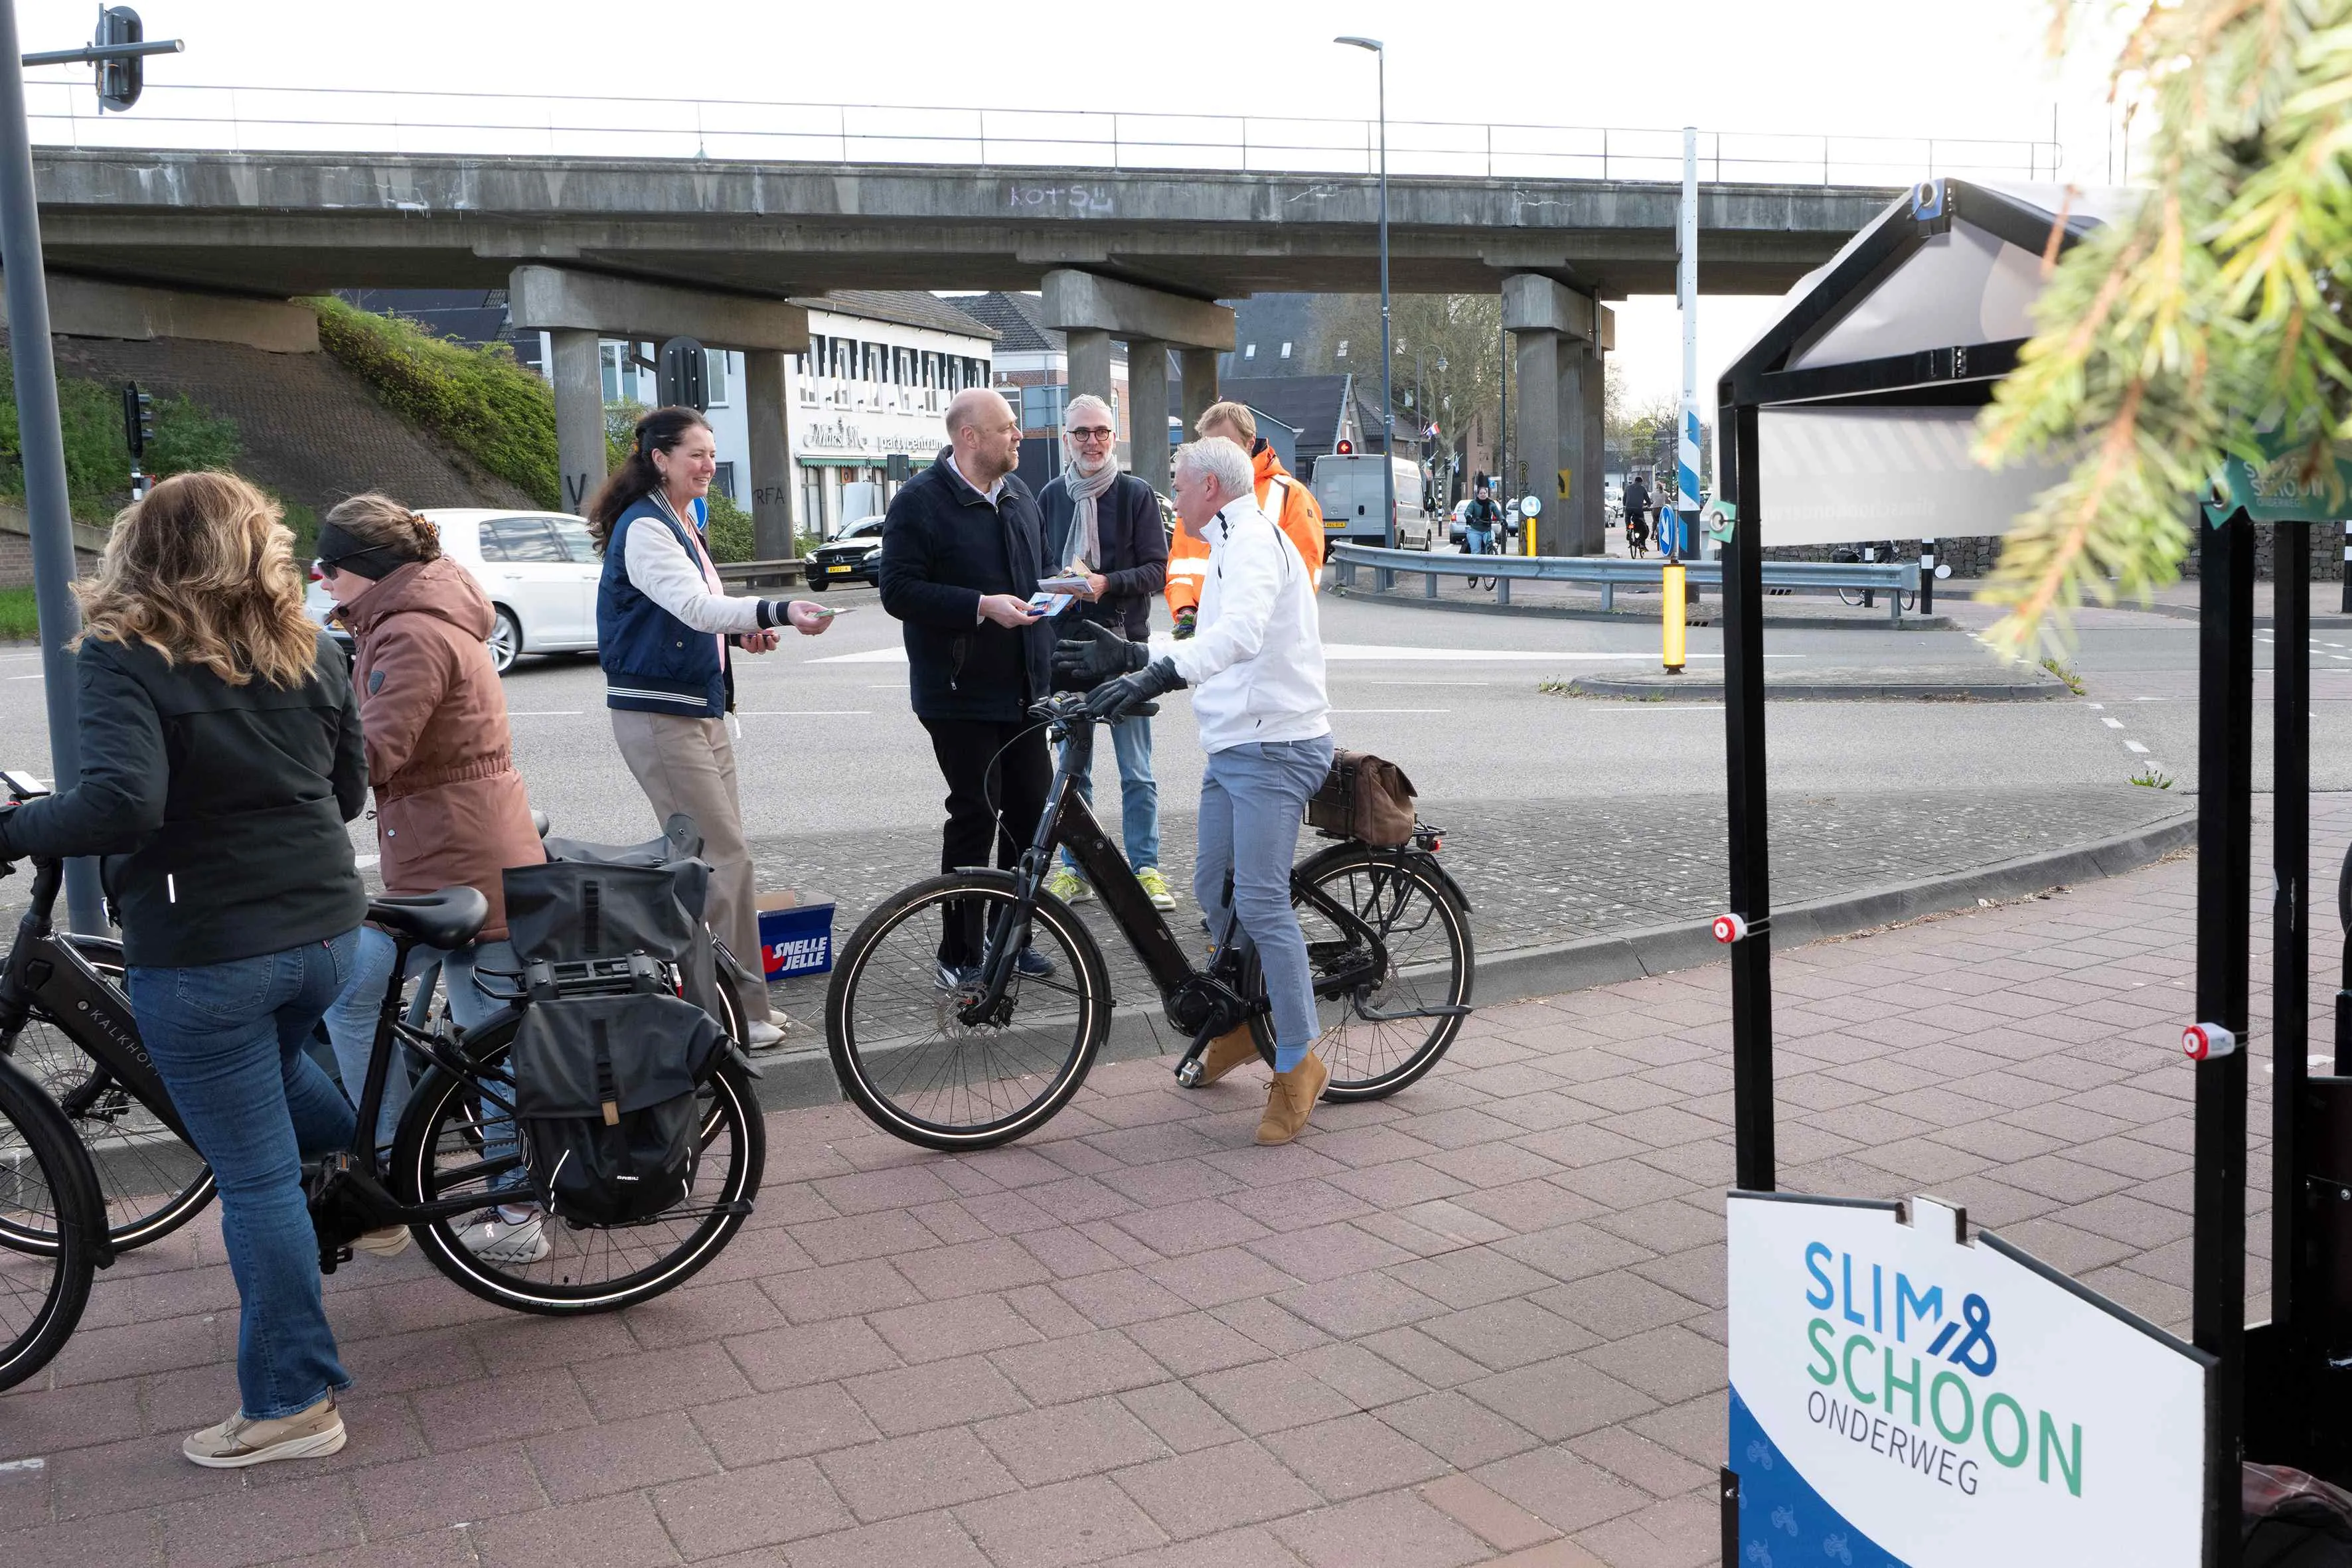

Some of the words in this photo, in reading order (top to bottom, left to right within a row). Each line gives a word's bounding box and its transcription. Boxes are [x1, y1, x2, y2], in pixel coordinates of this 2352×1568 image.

[753, 487, 785, 505] RFA
[773, 937, 828, 959] SNELLE
[782, 951, 824, 971] JELLE
[90, 1009, 160, 1076] KALKHO
[1806, 1318, 2082, 1498] SCHOON
[1808, 1391, 1978, 1495] ONDERWEG
